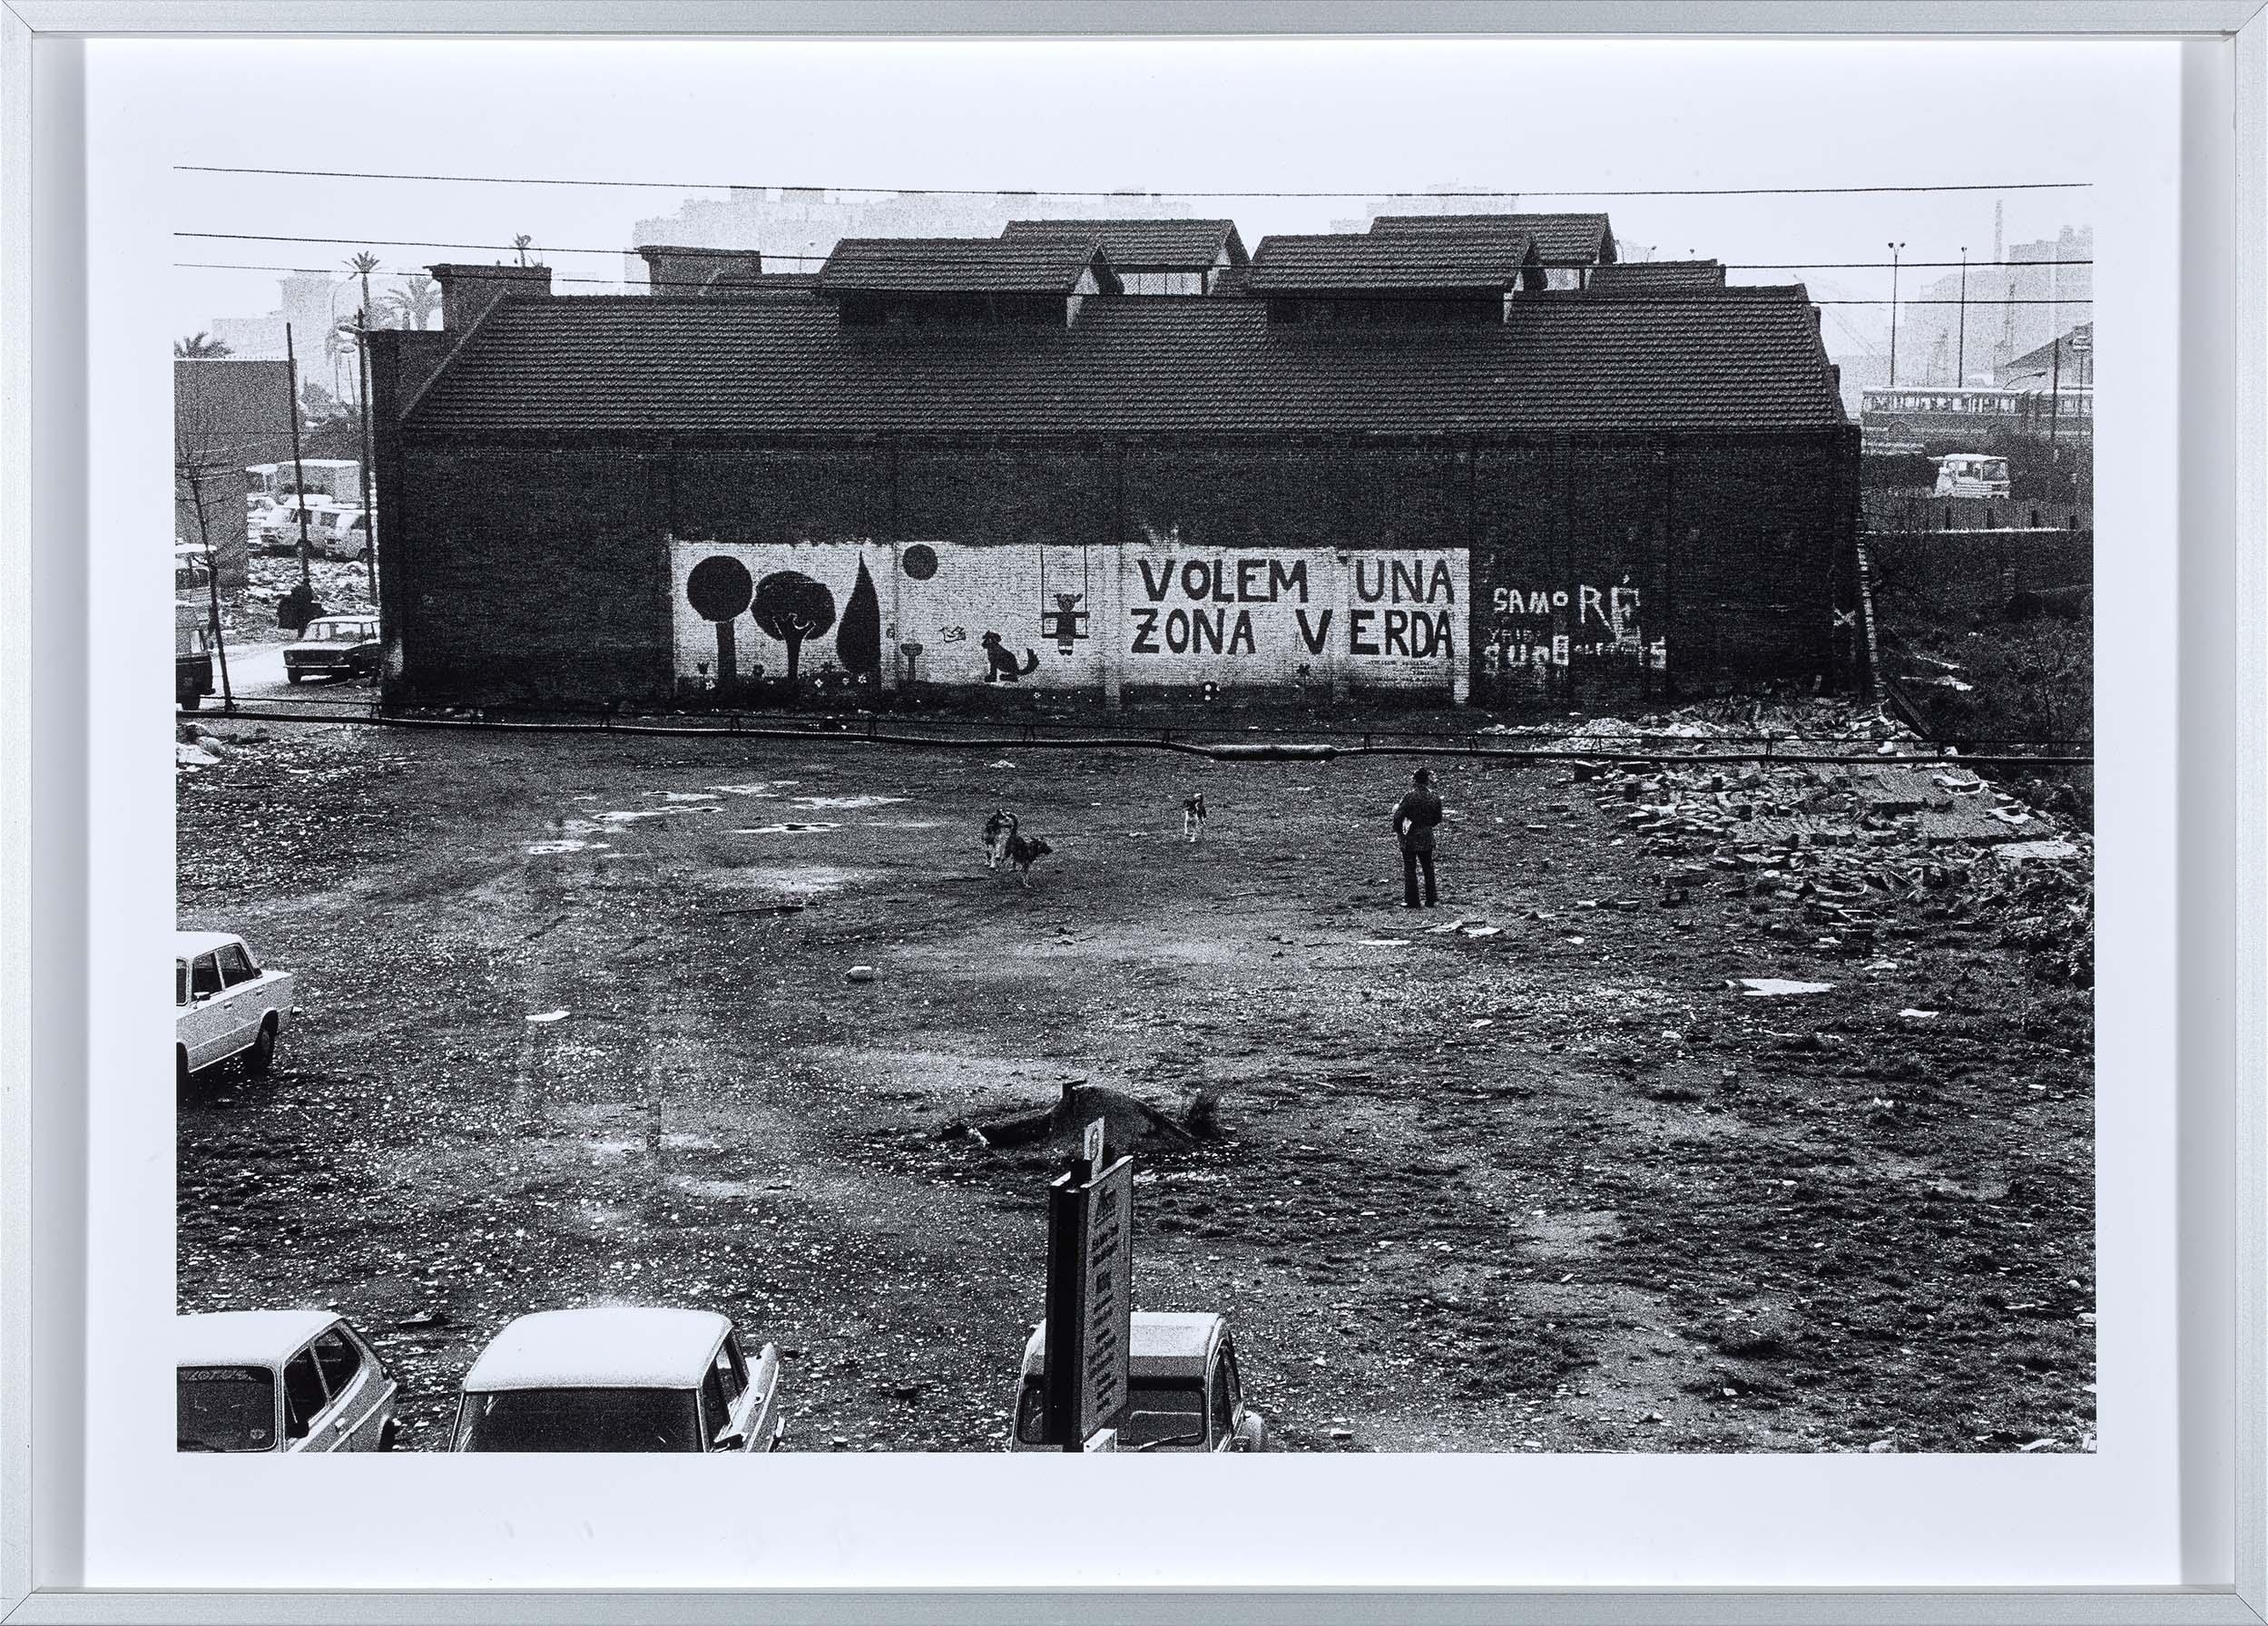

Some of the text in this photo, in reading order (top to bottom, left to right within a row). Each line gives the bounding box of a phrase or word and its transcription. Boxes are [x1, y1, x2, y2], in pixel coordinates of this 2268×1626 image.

[1137, 559, 1454, 603] VOLEM UNA
[1131, 608, 1255, 654] ZONA
